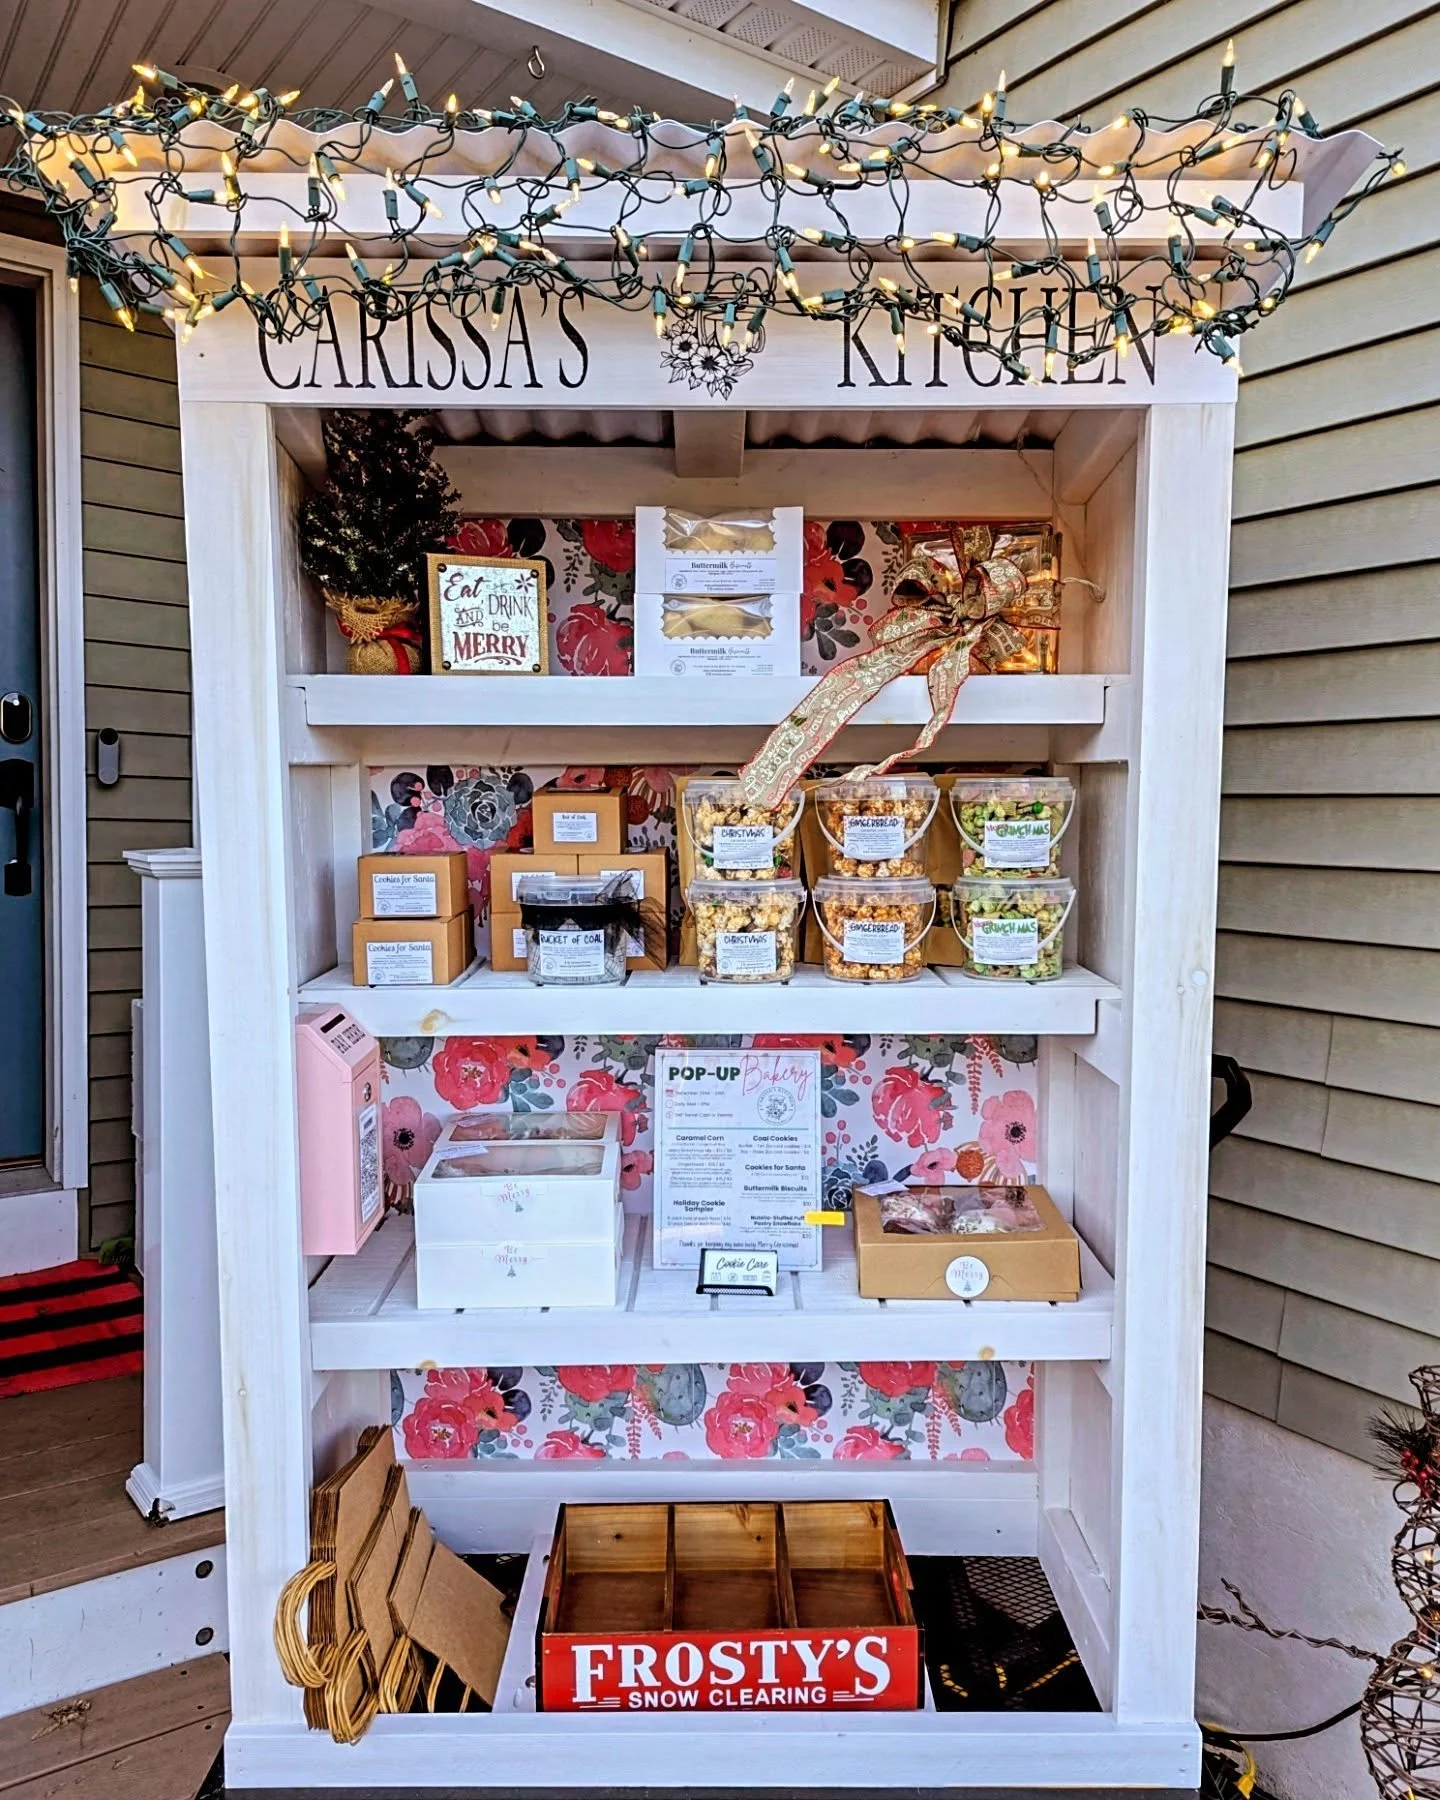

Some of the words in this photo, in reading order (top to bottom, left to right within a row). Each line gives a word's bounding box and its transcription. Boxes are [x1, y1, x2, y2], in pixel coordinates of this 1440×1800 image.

[258, 285, 588, 391] CARISSA'S
[837, 284, 1166, 388] KITCHEN
[488, 594, 534, 620] DRINK
[454, 607, 484, 627] AND
[492, 622, 510, 632] be
[452, 632, 530, 664] MERRY
[690, 647, 727, 655] Buttermilk
[848, 818, 899, 828] GINGERBREAD
[721, 828, 765, 838] CHRISTMAS
[374, 875, 401, 884] Cookies
[413, 875, 435, 884] Santa
[849, 923, 900, 933] GINGERBREAD
[540, 934, 568, 945] BUCKET
[584, 933, 603, 944] COAL
[724, 934, 768, 944] CHRISTMAS
[368, 943, 396, 953] Cookies
[408, 943, 432, 952] Santa
[330, 1033, 352, 1054] PAY
[669, 1066, 741, 1081] POP-UP
[739, 1055, 814, 1101] Bakery
[673, 1199, 700, 1207] Holiday
[716, 1257, 746, 1271] Cookie
[746, 1258, 769, 1272] Care
[570, 1636, 892, 1703] FROSTY'S
[628, 1690, 699, 1709] SNOW
[708, 1686, 827, 1706] CLEARING
